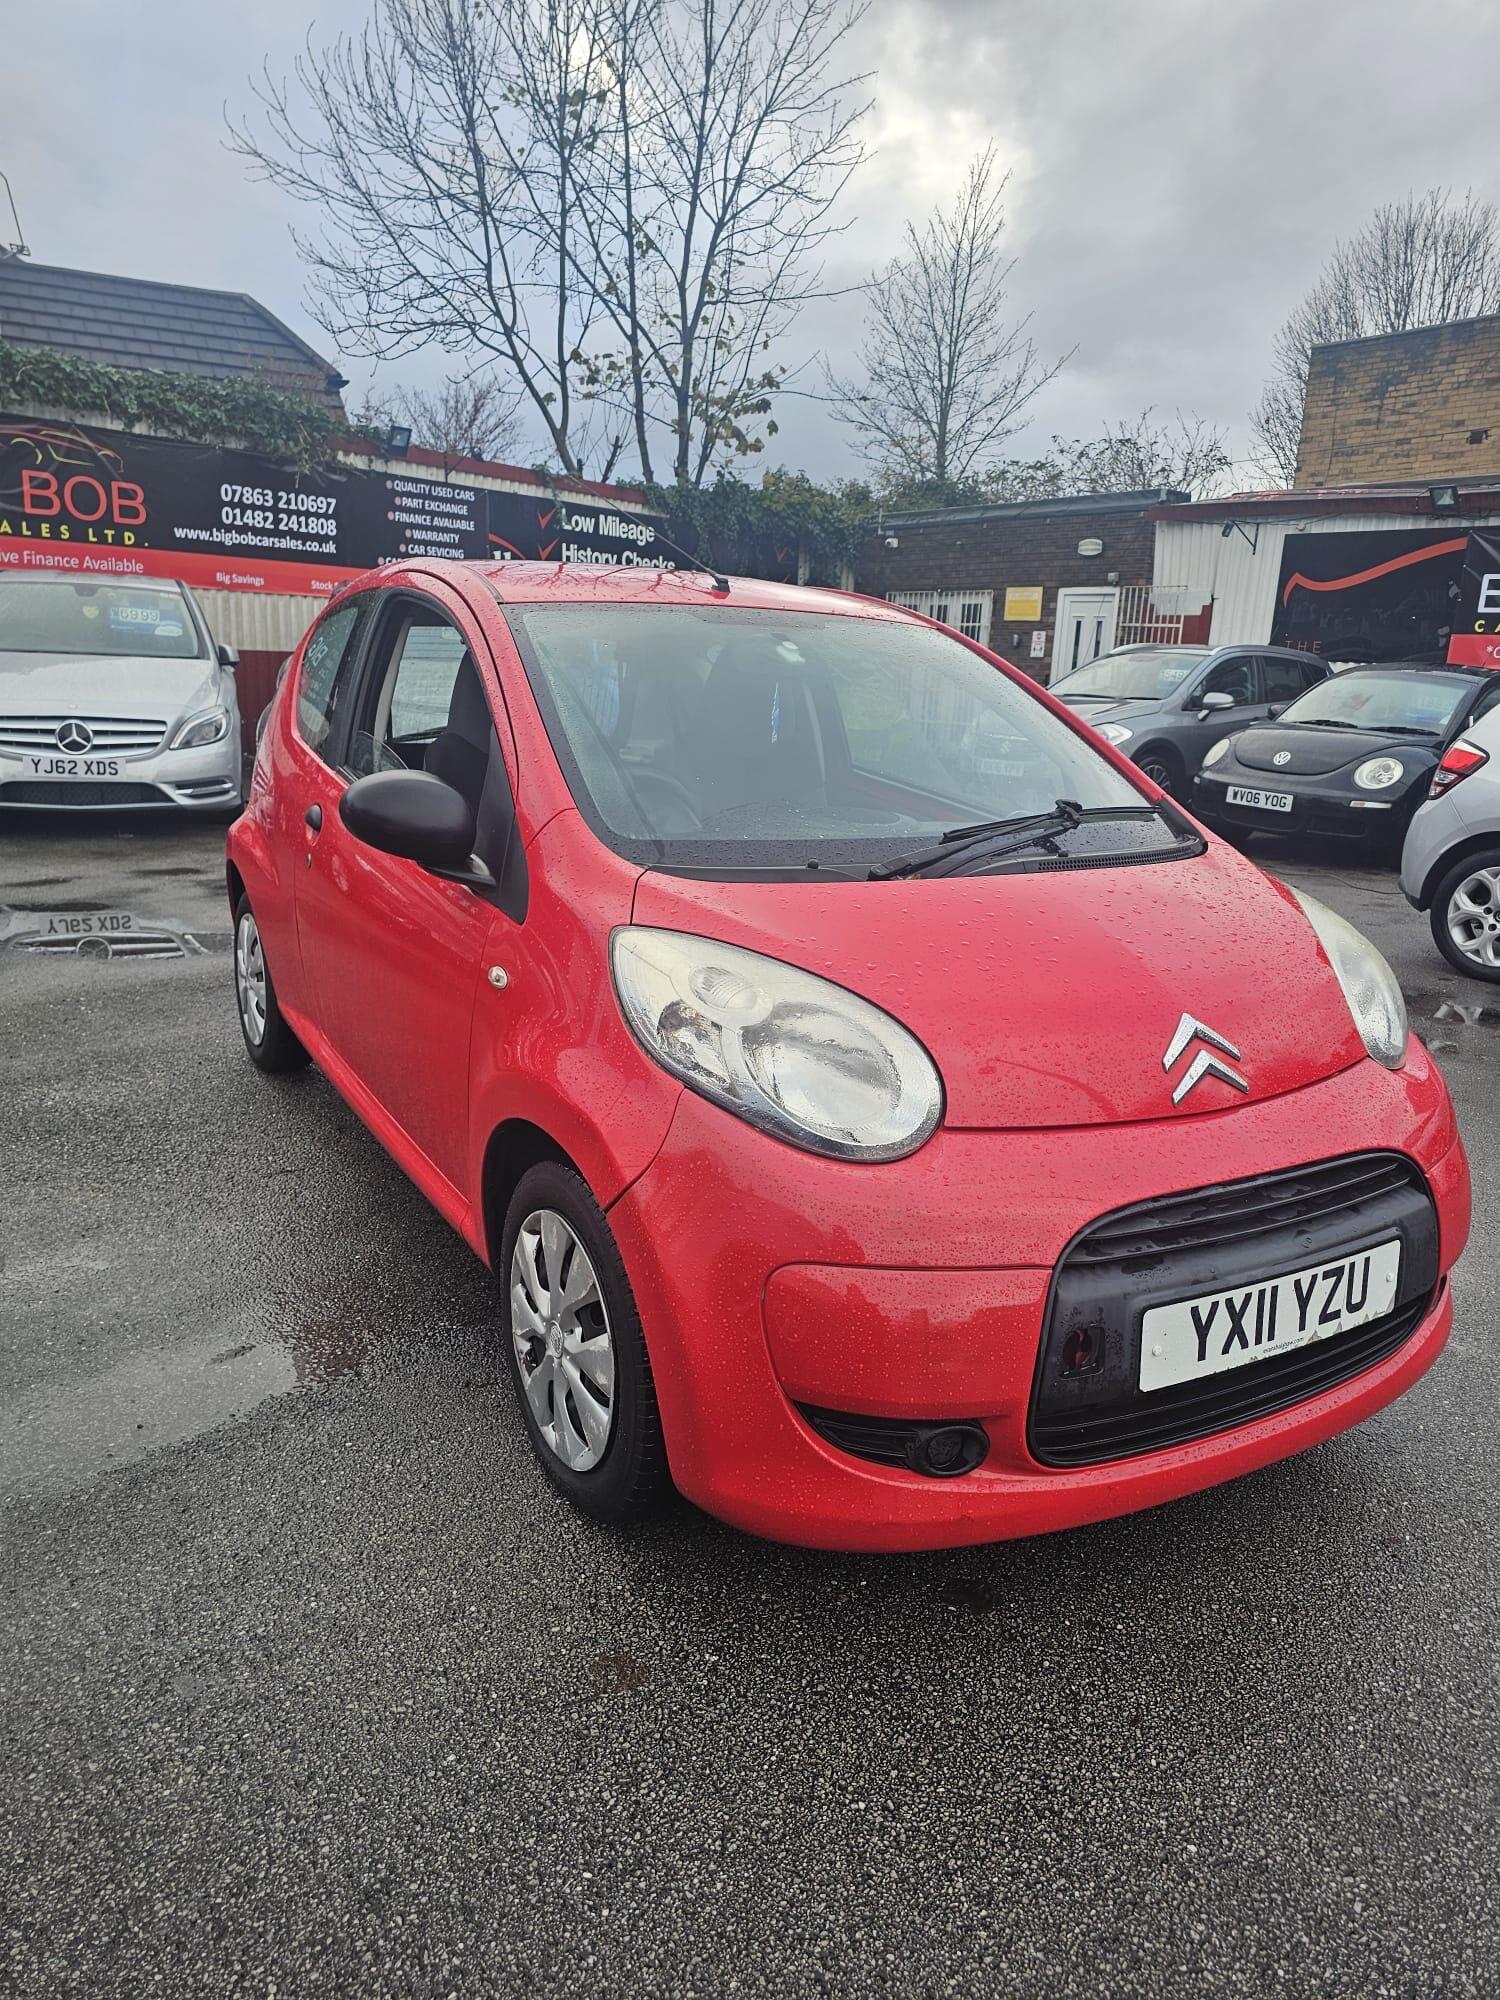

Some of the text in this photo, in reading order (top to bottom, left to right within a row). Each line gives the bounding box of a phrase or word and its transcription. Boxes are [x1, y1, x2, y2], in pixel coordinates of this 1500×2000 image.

[22, 469, 147, 525] BOB
[220, 484, 336, 514] 07863 210697
[394, 480, 475, 501] QUALITY USED CARS
[402, 497, 468, 515] PART EXCHANGE
[221, 507, 336, 536] 01482 241808
[395, 512, 475, 531] FINANCE AVALIABLE
[562, 508, 655, 546] Low Mileage
[88, 528, 149, 547] LTD.
[174, 527, 337, 553] www.bigbobcarsales.co.uk
[412, 529, 460, 544] WARRANTY
[408, 544, 464, 559] CAR SEVICING
[23, 550, 80, 568] Finance
[83, 556, 144, 573] Available
[216, 572, 265, 586] Big Savings
[311, 580, 333, 590] Stock
[31, 758, 119, 776] YJ62 XDS
[1232, 790, 1287, 808] WV06 YOG
[1294, 1256, 1371, 1333] YZU
